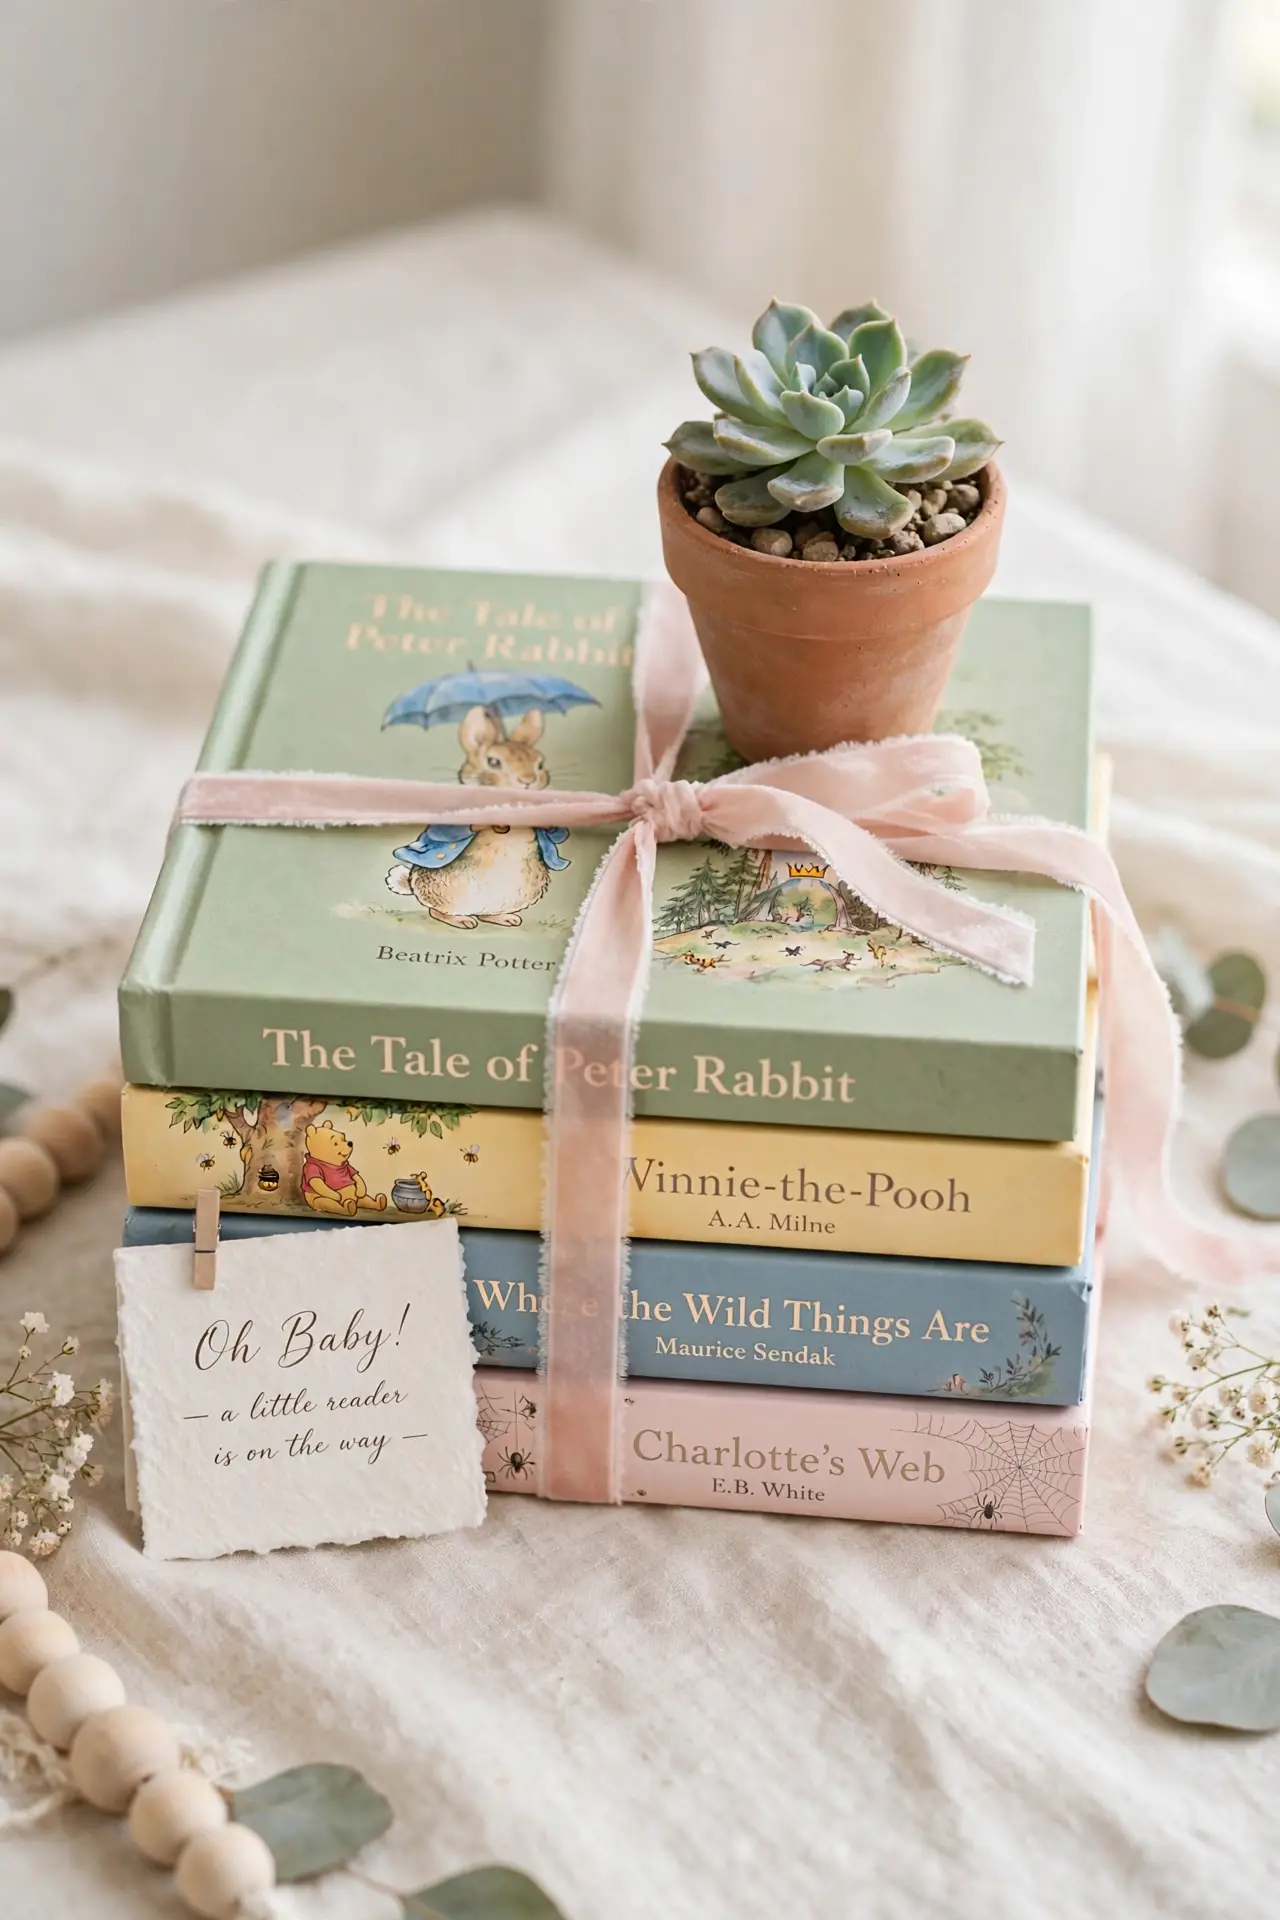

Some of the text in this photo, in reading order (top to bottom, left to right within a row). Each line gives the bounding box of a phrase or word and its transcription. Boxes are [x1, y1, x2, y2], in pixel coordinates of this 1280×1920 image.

[347, 621, 466, 656] Peter
[376, 945, 557, 972] Beatrix Potter
[262, 1028, 856, 1103] The Tale of Peter Rabbit
[707, 1209, 836, 1234] A.A. Milne
[194, 1302, 411, 1374] Oh Baby!
[682, 1292, 772, 1329] Wild
[783, 1298, 911, 1346] Things
[921, 1309, 990, 1343] Are
[655, 1336, 836, 1366] Maurice Sendak
[221, 1407, 239, 1422] a
[250, 1388, 318, 1420] little
[326, 1380, 409, 1411] reader
[213, 1447, 238, 1466] is
[246, 1447, 280, 1462] on
[285, 1428, 330, 1457] the
[339, 1434, 392, 1465] way
[632, 1429, 946, 1484] Charlotte’s Web
[711, 1478, 826, 1501] E.B. White
